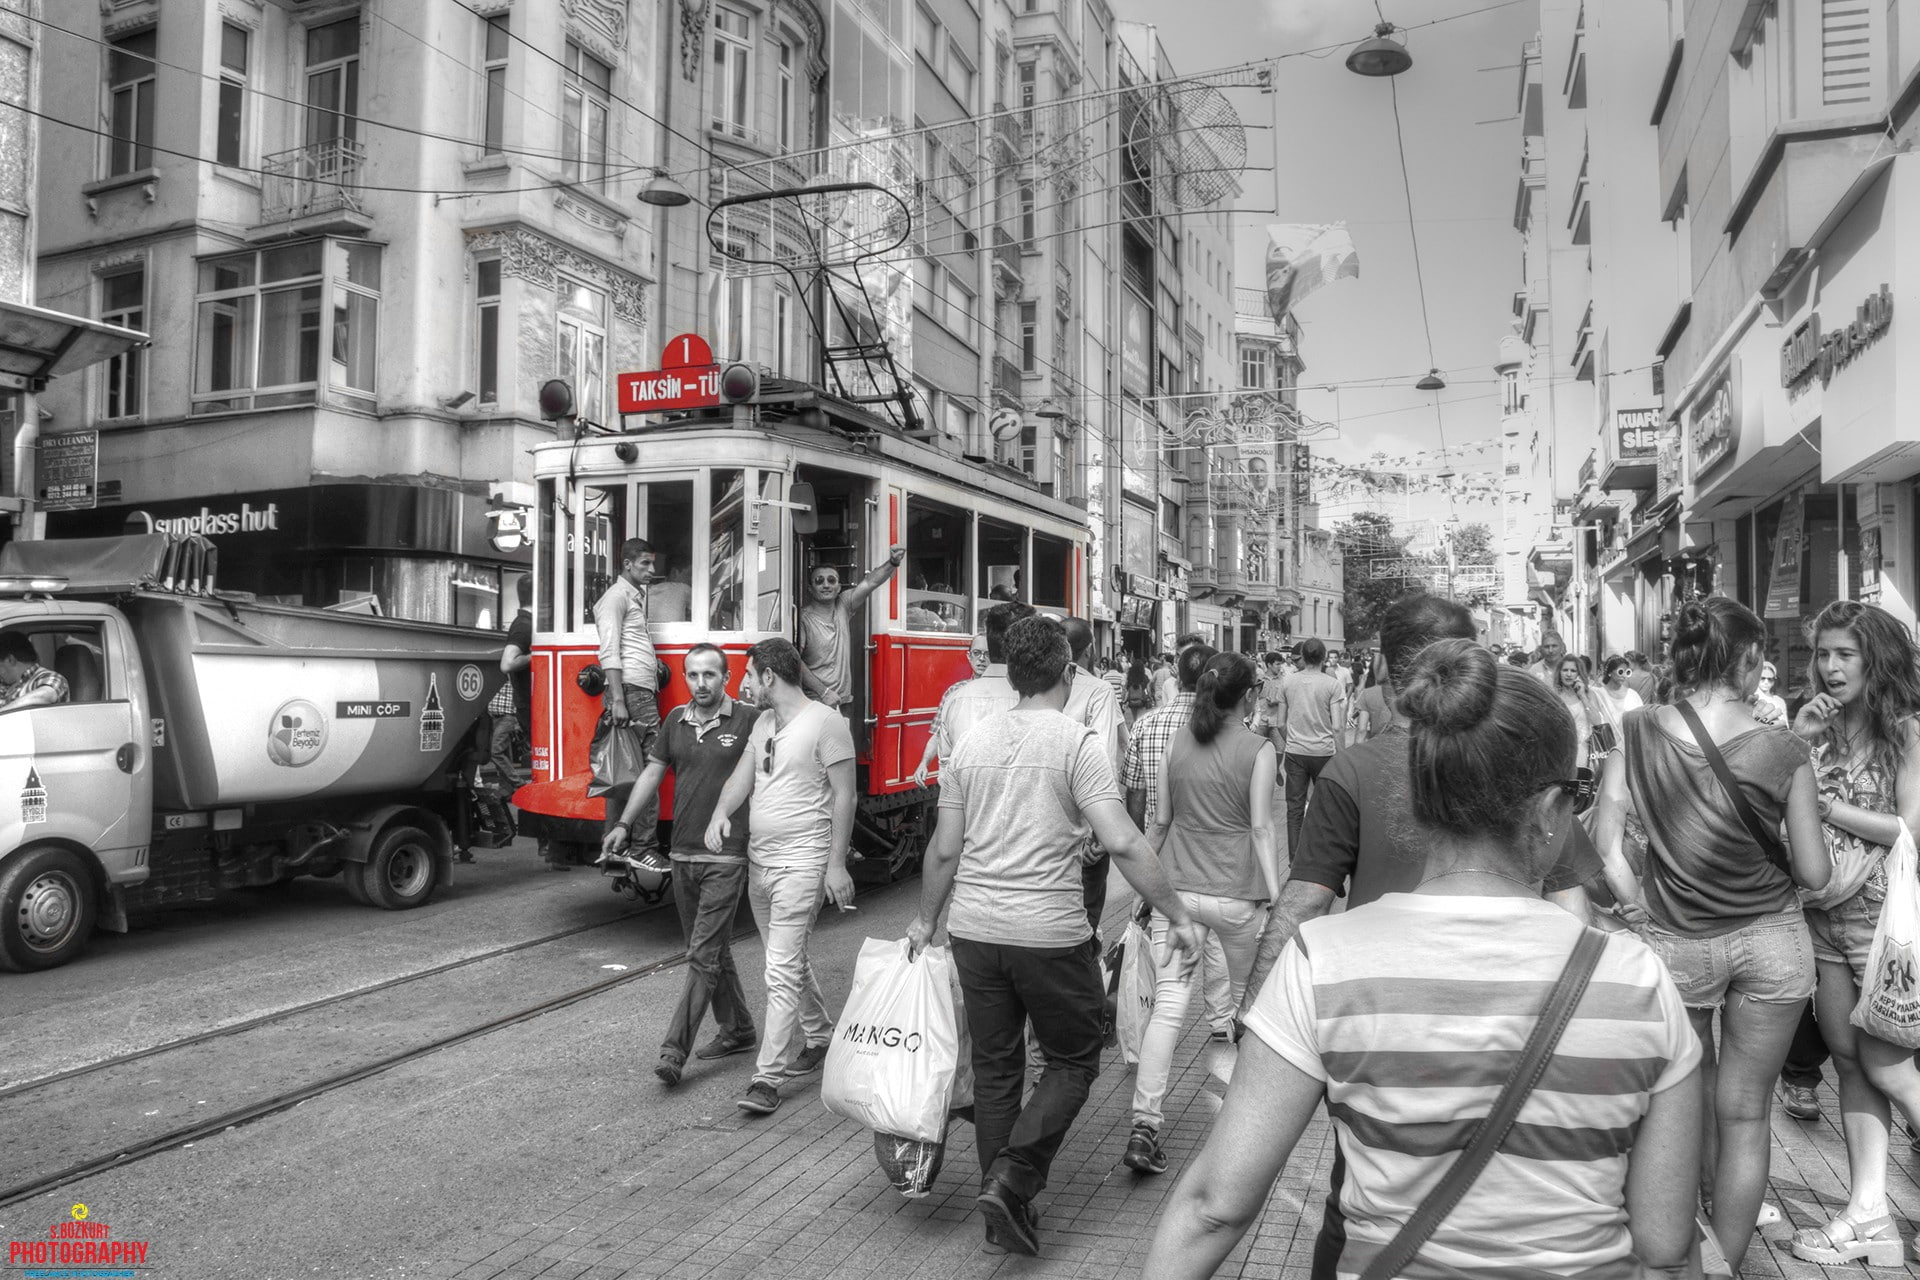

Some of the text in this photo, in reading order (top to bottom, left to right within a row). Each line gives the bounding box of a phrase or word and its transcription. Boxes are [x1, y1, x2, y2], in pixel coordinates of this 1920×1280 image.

[682, 337, 690, 364] 1
[57, 434, 94, 447] CLEANING
[155, 503, 278, 537] sunglass hut
[462, 672, 478, 692] 66
[843, 1023, 922, 1053] MANGO
